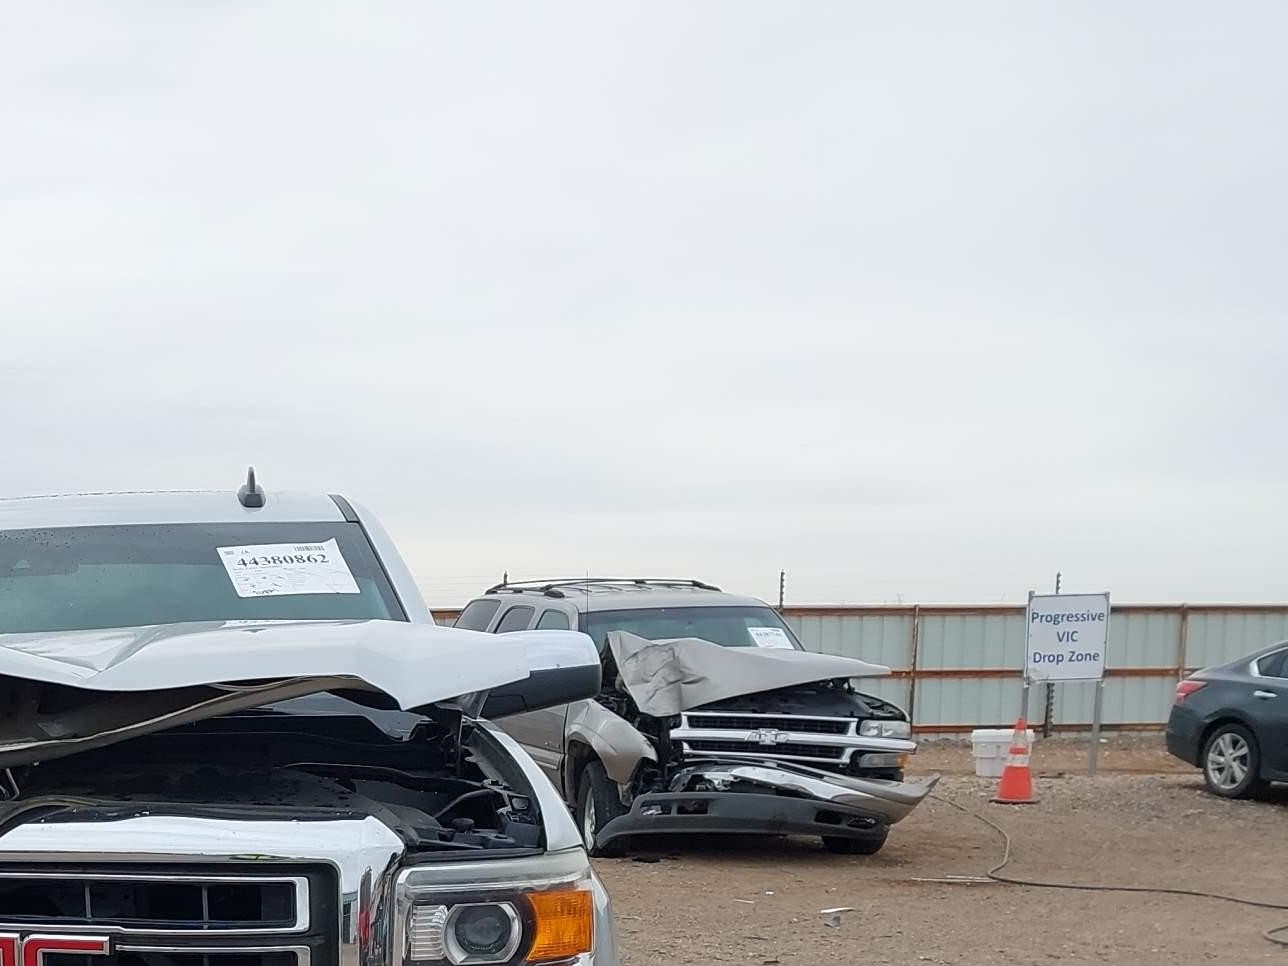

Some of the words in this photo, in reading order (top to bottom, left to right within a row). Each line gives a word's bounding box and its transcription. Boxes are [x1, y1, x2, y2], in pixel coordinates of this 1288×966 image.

[237, 553, 330, 567] 44380862
[1031, 609, 1105, 626] Progressive
[1056, 630, 1079, 642] VIC
[1032, 651, 1064, 665] Drop
[1068, 650, 1100, 662] Zone
